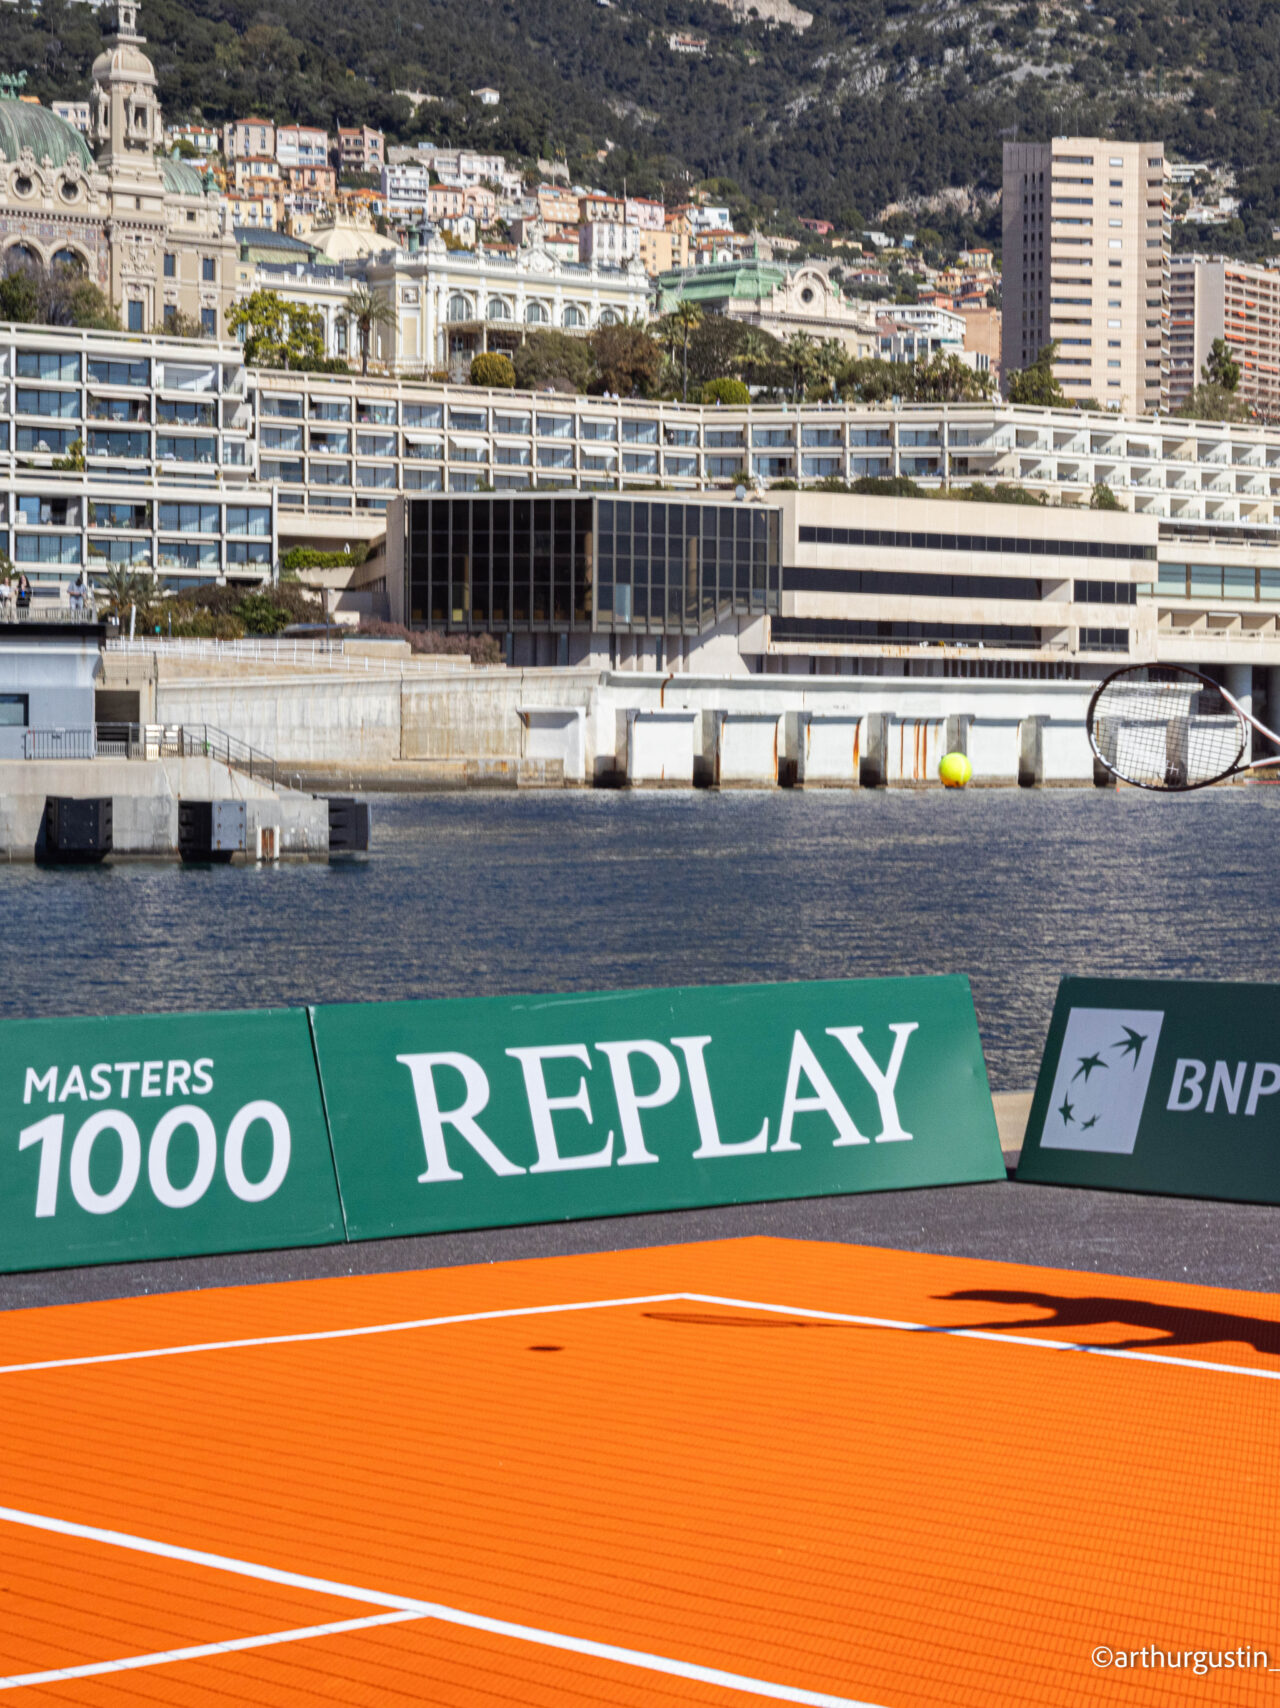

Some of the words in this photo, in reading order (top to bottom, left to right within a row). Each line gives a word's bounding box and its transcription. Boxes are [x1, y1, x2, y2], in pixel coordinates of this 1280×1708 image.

[23, 1058, 214, 1104] MASTERS
[396, 1022, 920, 1184] REPLAY
[19, 1099, 291, 1218] 1000
